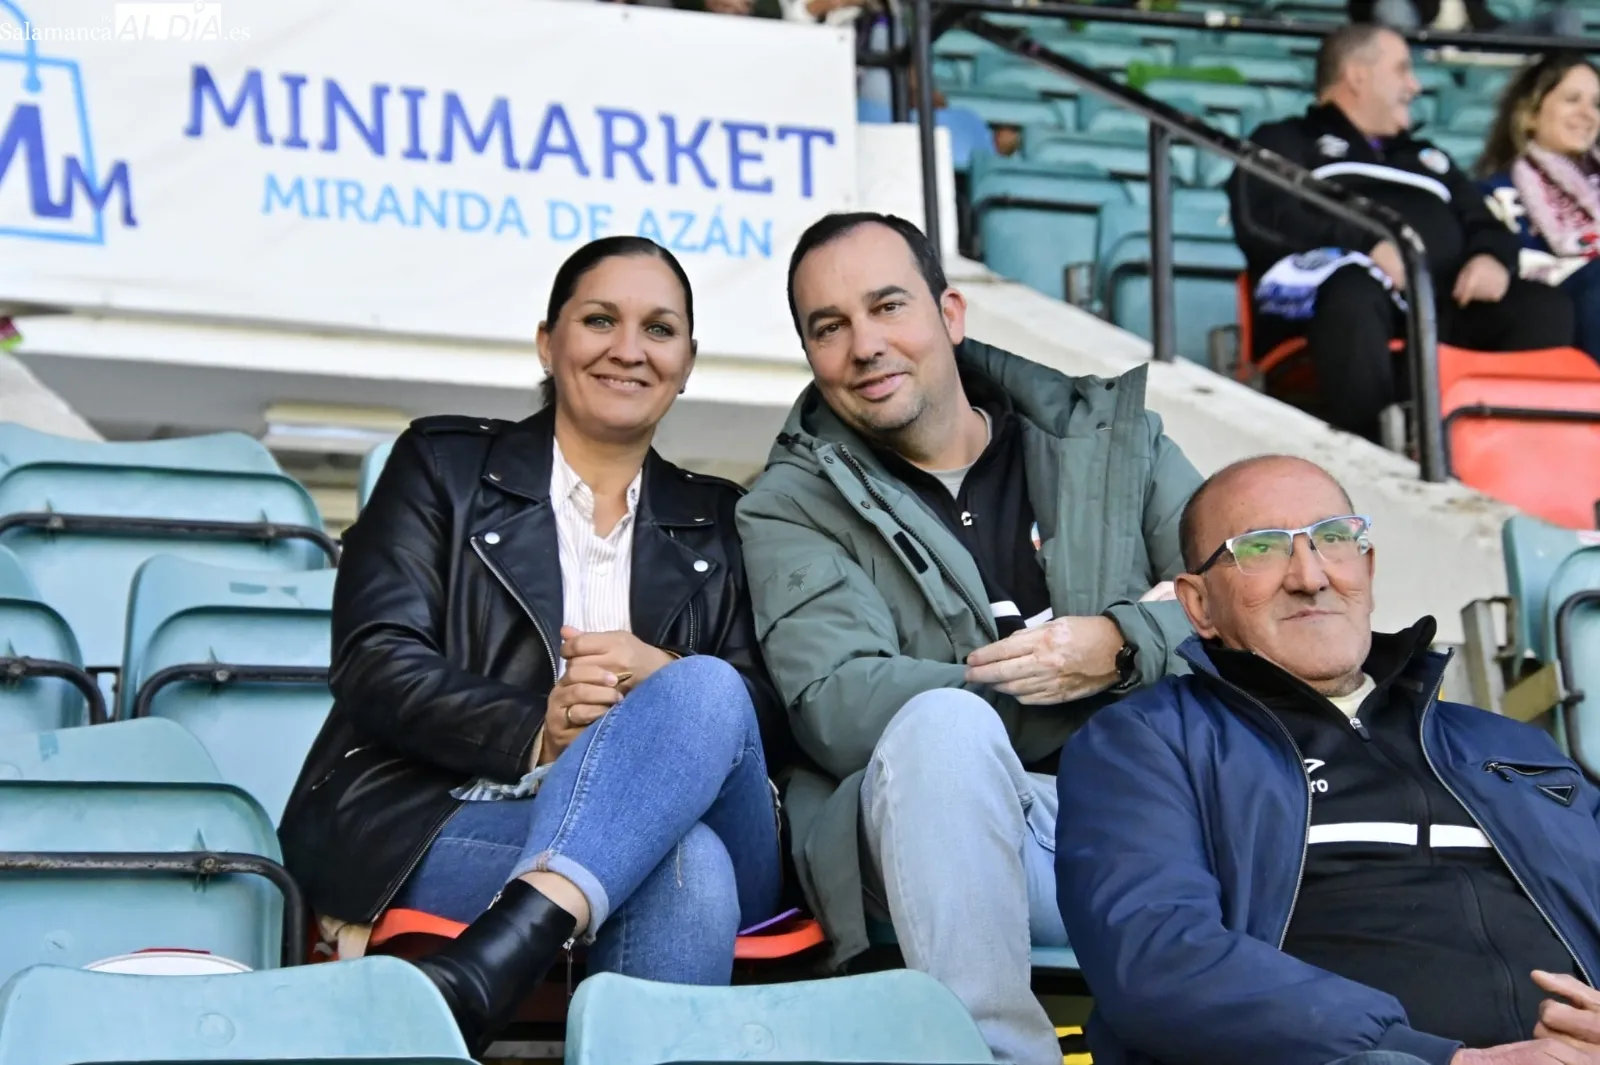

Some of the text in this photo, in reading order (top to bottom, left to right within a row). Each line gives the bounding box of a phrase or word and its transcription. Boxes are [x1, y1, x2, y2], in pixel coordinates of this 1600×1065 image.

[183, 64, 837, 199] MINIMARKET
[260, 172, 773, 258] MIRANDA DE AZÁN
